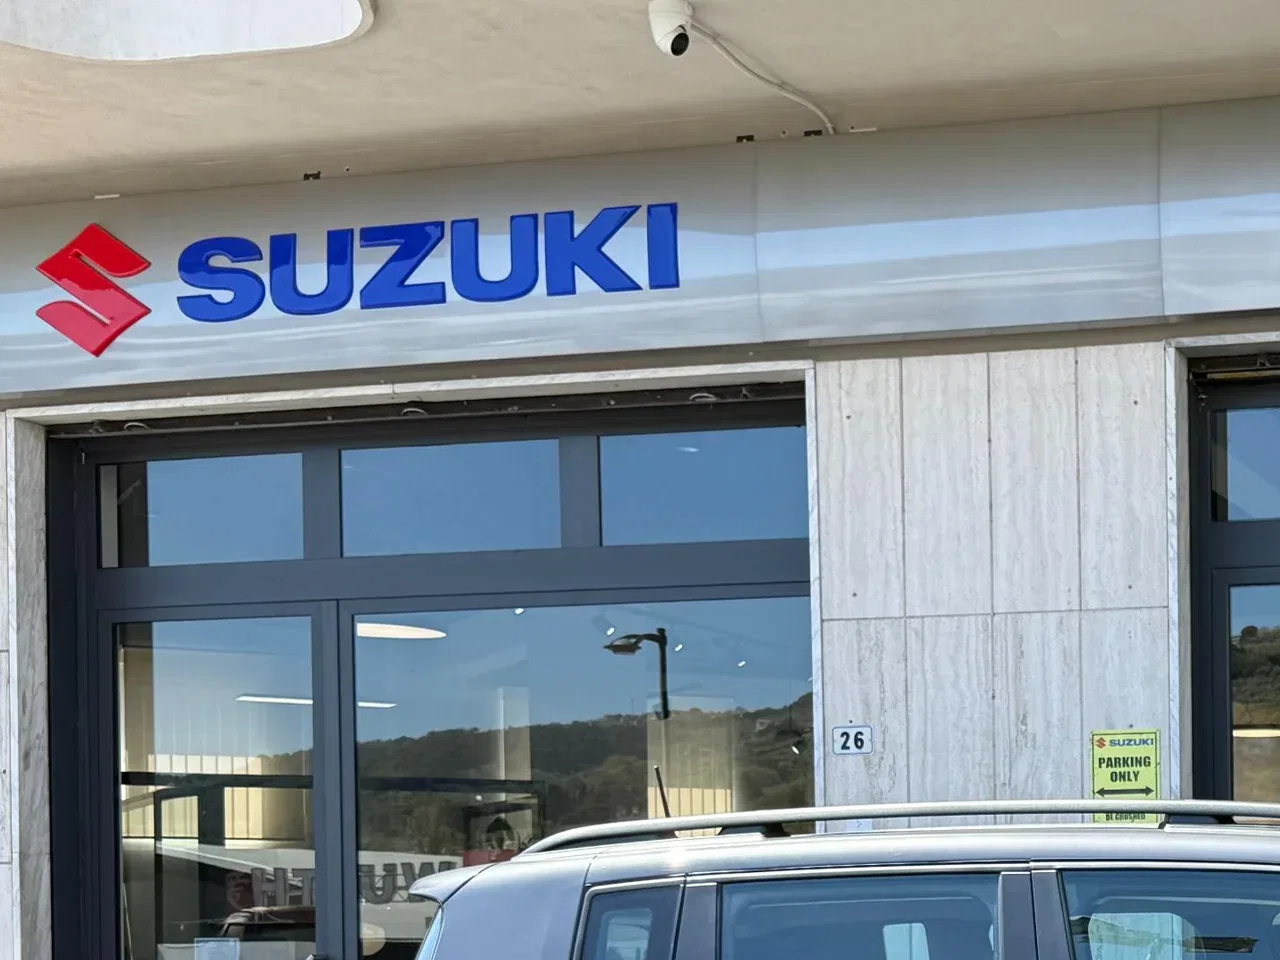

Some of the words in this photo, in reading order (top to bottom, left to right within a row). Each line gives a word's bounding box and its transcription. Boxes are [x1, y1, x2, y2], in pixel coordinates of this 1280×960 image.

[177, 202, 680, 322] SUZUKI
[840, 731, 865, 750] 26
[1109, 738, 1154, 747] SUZUKI
[1098, 756, 1151, 769] PARKING
[1110, 771, 1140, 783] ONLY
